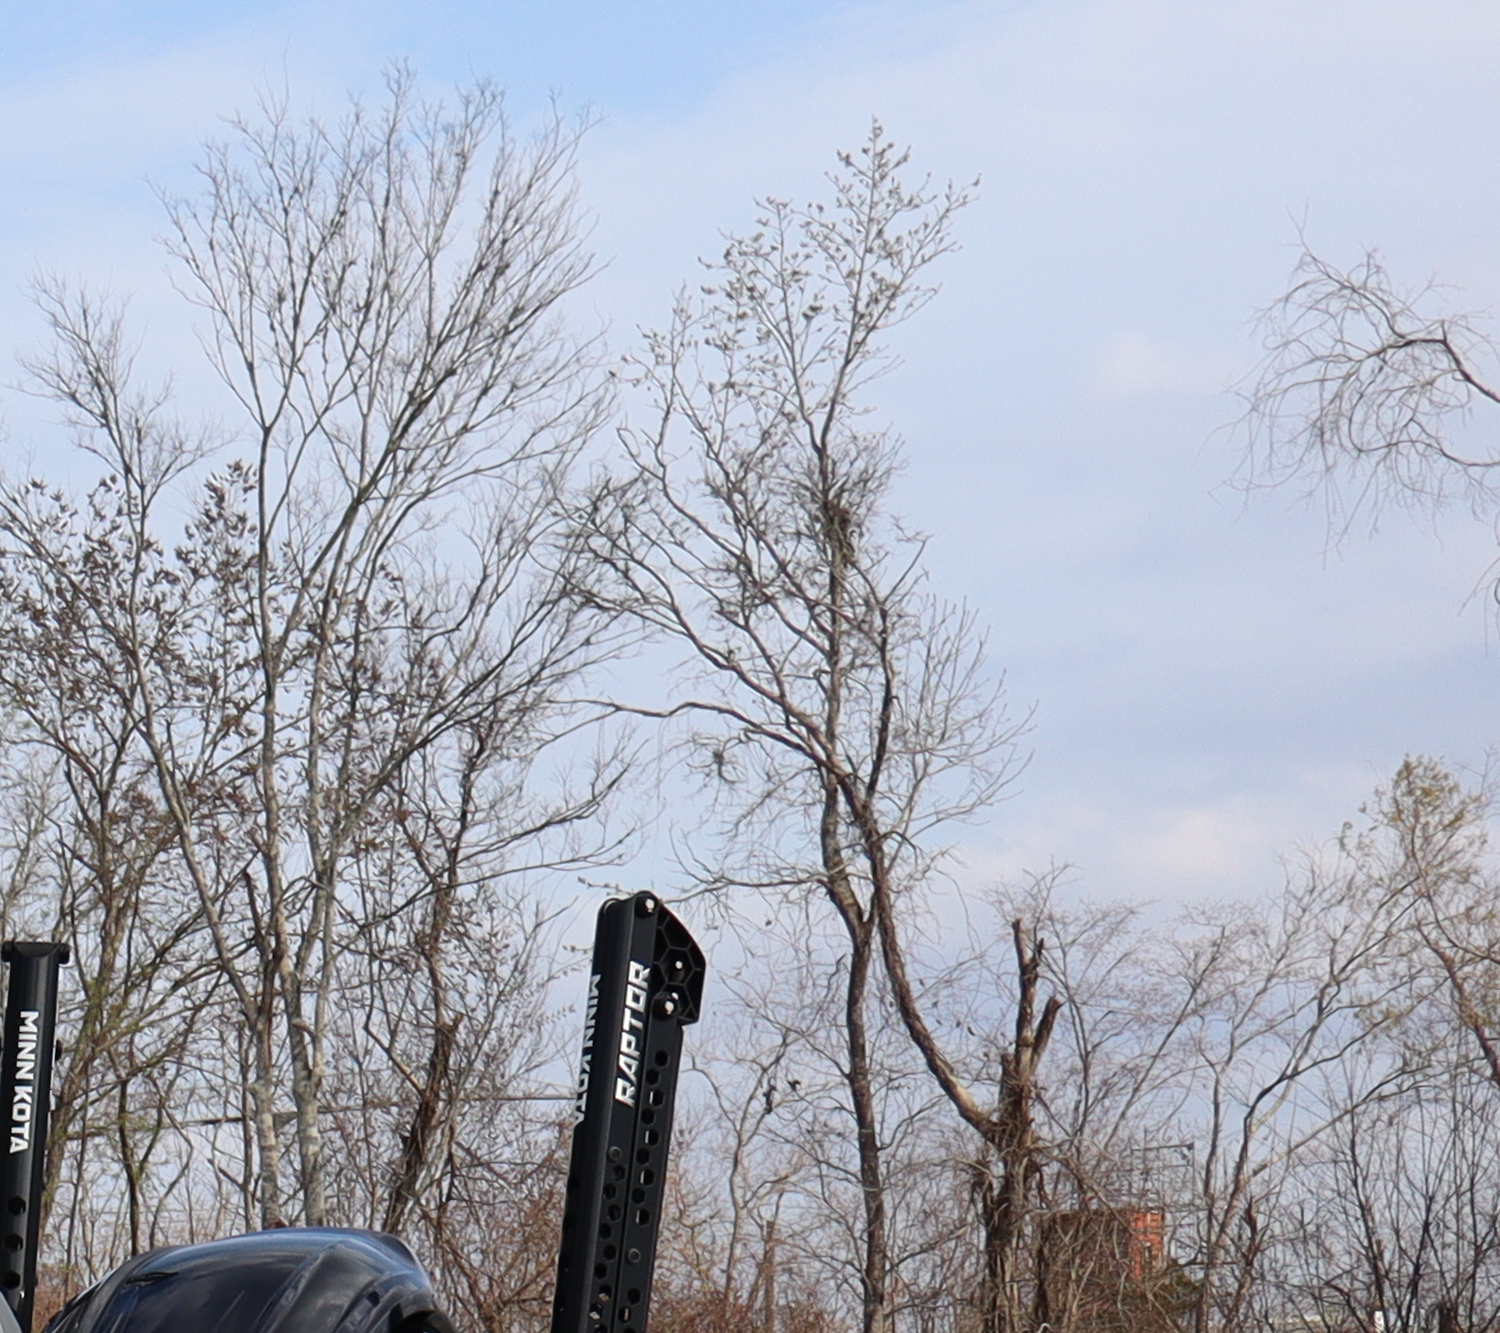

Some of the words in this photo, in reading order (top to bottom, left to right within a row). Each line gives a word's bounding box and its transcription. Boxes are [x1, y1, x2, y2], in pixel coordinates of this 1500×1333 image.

[15, 1010, 39, 1080] MINN
[614, 960, 650, 1107] RAPTOR
[9, 1085, 33, 1154] KOTA
